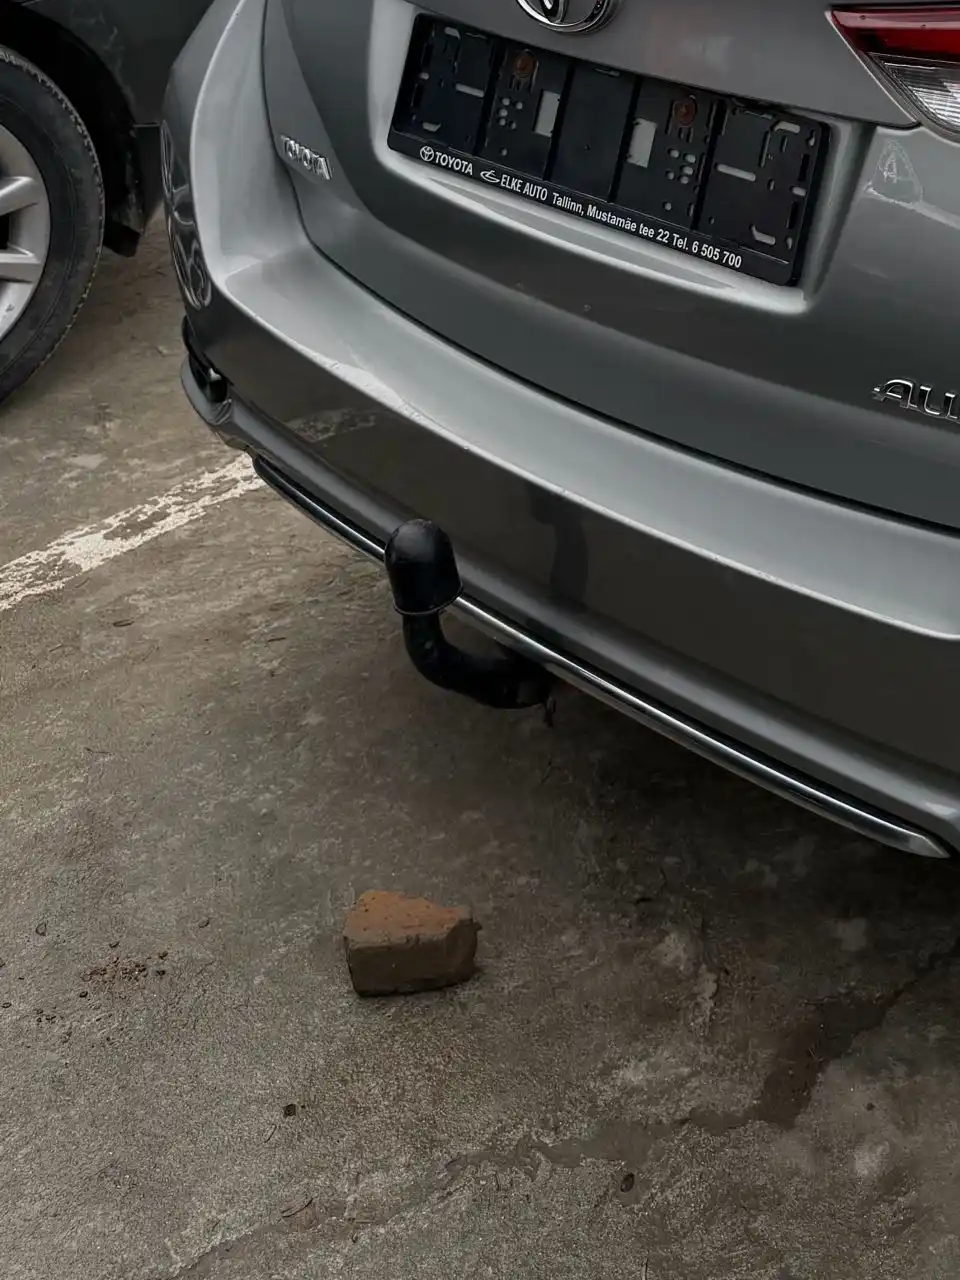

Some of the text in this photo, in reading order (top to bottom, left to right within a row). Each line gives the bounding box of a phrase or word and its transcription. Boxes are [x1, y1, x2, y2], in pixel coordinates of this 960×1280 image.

[281, 135, 332, 180] TOYOTA
[434, 151, 742, 269] TOYOTA ELKE AUTO Tallinn, Mustamäe tee 22 Tel. 6 505 700
